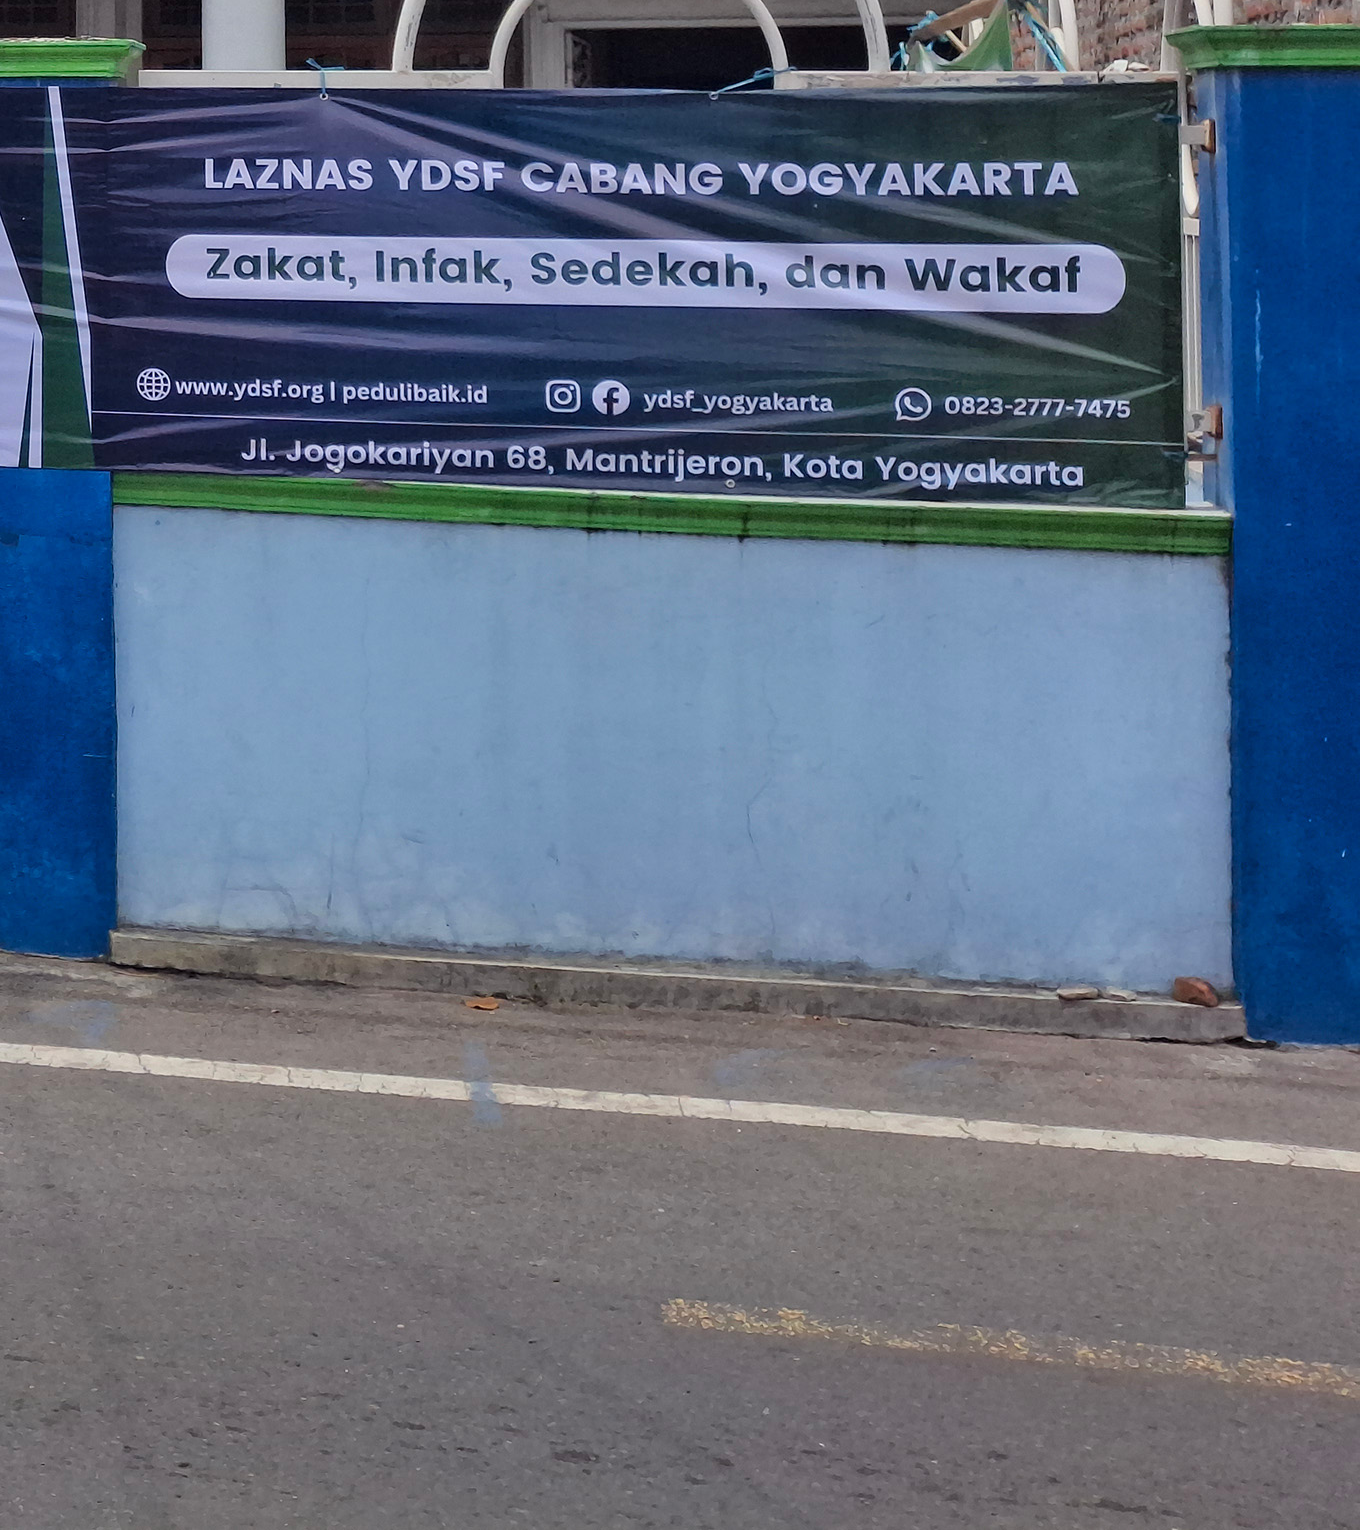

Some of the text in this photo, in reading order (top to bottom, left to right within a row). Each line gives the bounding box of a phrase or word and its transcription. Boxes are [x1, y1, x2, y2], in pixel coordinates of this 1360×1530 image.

[204, 158, 1080, 196] LAZNAS YDSF CABANG YOGYAKARTA
[205, 247, 1083, 296] Zakat, Infak, Sedekah, dan Wakaf
[175, 378, 324, 404] www.ydsf.org
[342, 381, 488, 405] pedulibaik.id
[643, 389, 834, 415] ydsf_yogyakarta
[944, 396, 1131, 419] 0823-2777-7475
[241, 439, 1085, 490] Jl. Jogokariyan 68, Mantrijeron, Kota Yogyakarta
